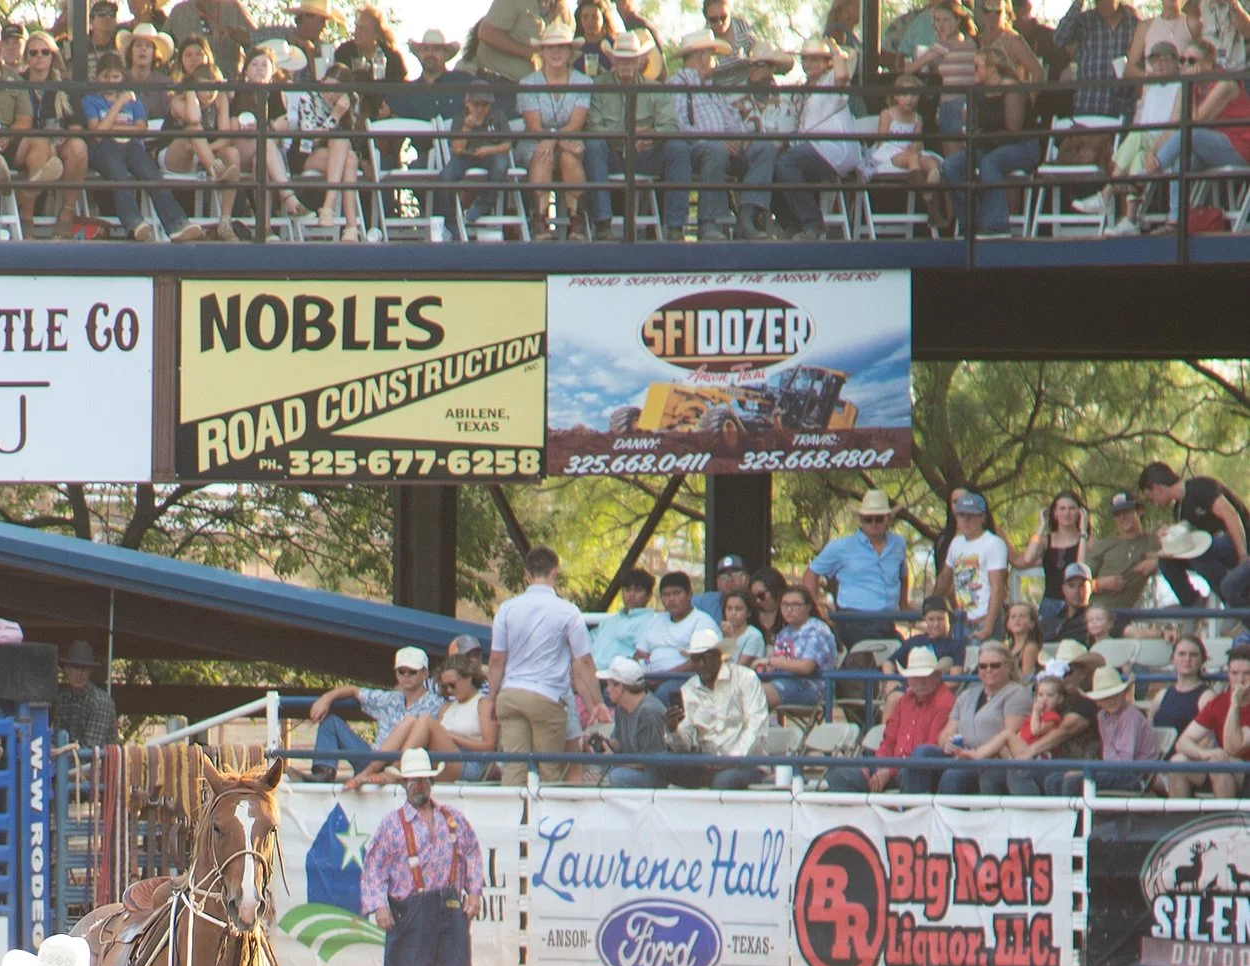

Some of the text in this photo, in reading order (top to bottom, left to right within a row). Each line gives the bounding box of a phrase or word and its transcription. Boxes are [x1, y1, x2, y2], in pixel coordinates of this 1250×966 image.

[569, 276, 619, 287] PROUD
[625, 275, 711, 286] SUPPORTER
[716, 274, 734, 284] OF
[741, 273, 764, 283] THE
[770, 272, 821, 283] ANSON
[84, 302, 140, 352] CO
[200, 293, 445, 353] NOBLES
[686, 362, 767, 384] Anson Texas
[198, 397, 307, 473] ROAD
[317, 334, 542, 429] CONSTRUCTION
[445, 407, 511, 420] ABILENE,
[456, 421, 500, 433] TEXAS
[792, 433, 840, 447] TRAVIS:
[259, 450, 541, 476] PH. 325-677-6258
[563, 453, 711, 475] 325.668.0411
[738, 448, 895, 470] 325.668.4804
[30, 736, 45, 949] W-W RODEO
[532, 818, 705, 902] Lawrence
[705, 824, 786, 901] Hall
[884, 836, 1054, 921] Big Red's
